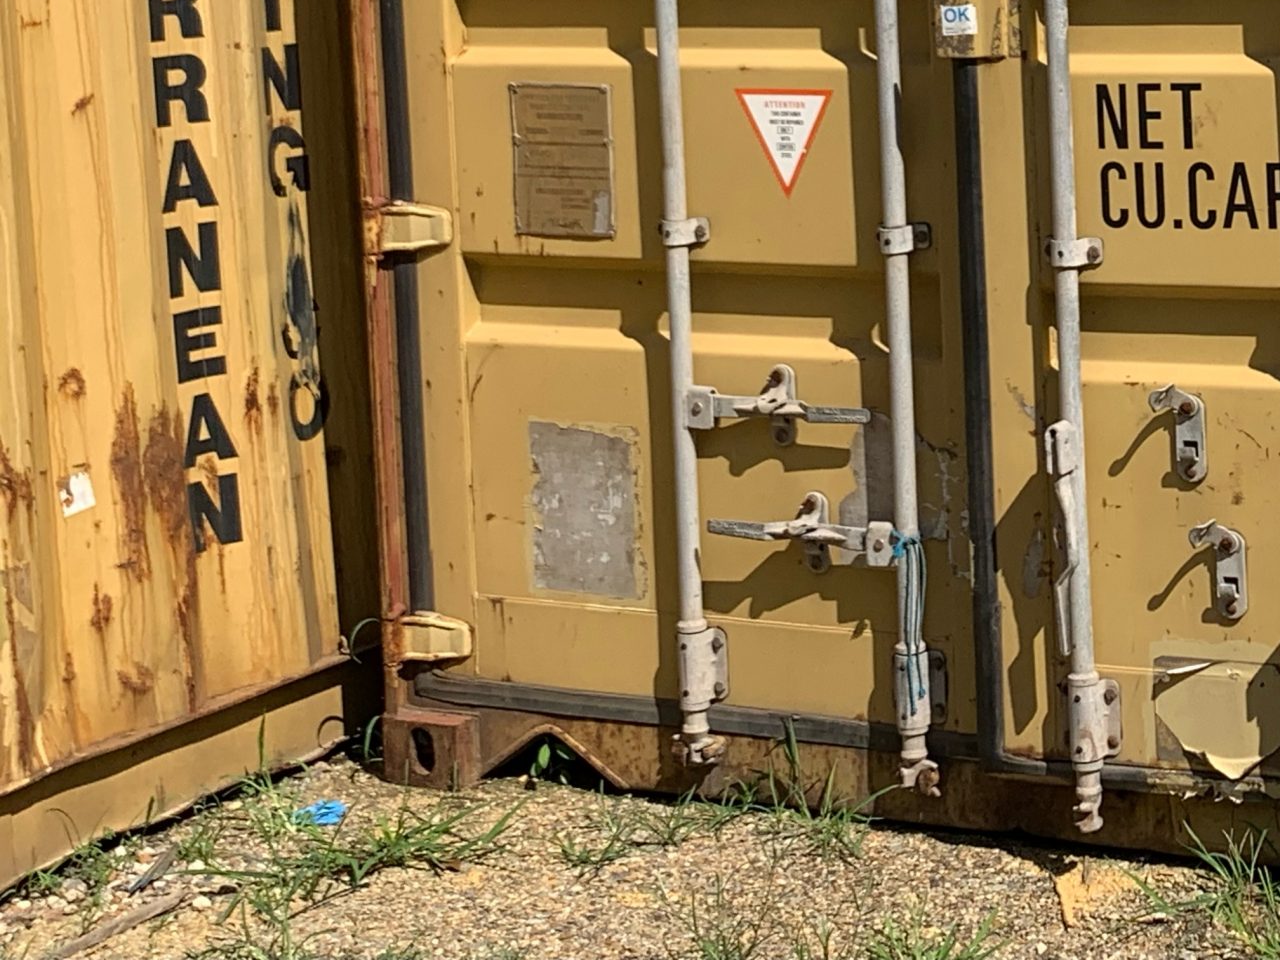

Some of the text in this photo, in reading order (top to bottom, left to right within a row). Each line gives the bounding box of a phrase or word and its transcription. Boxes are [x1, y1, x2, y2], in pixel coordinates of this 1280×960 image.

[944, 7, 971, 23] OK
[765, 101, 806, 109] ATTENTION
[1095, 83, 1202, 150] NET
